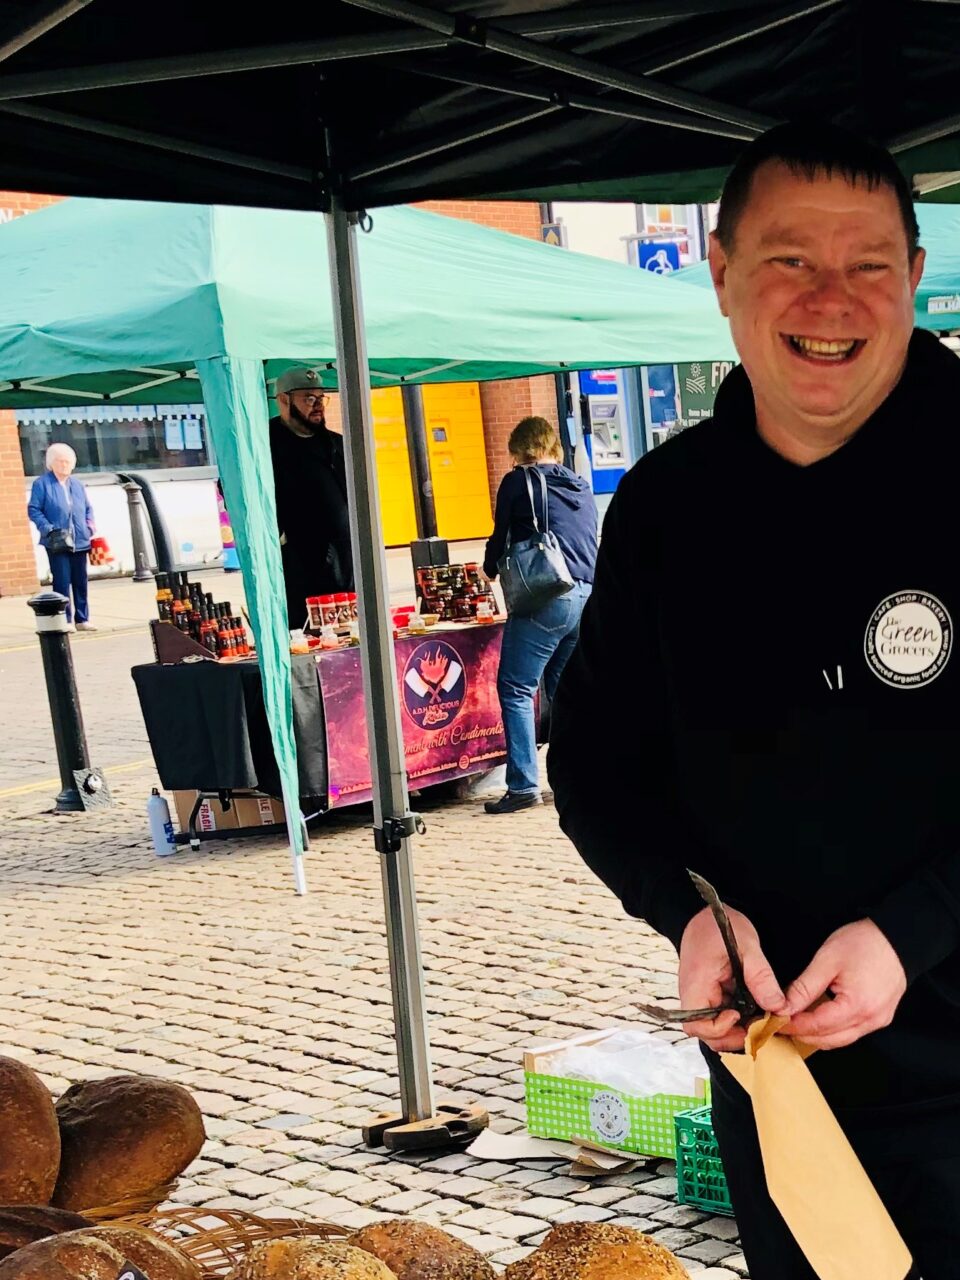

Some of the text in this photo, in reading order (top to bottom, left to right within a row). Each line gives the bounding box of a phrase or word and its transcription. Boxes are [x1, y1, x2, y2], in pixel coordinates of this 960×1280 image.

[895, 595, 917, 605] SHOP
[881, 625, 938, 643] Green
[881, 642, 934, 656] Grocers
